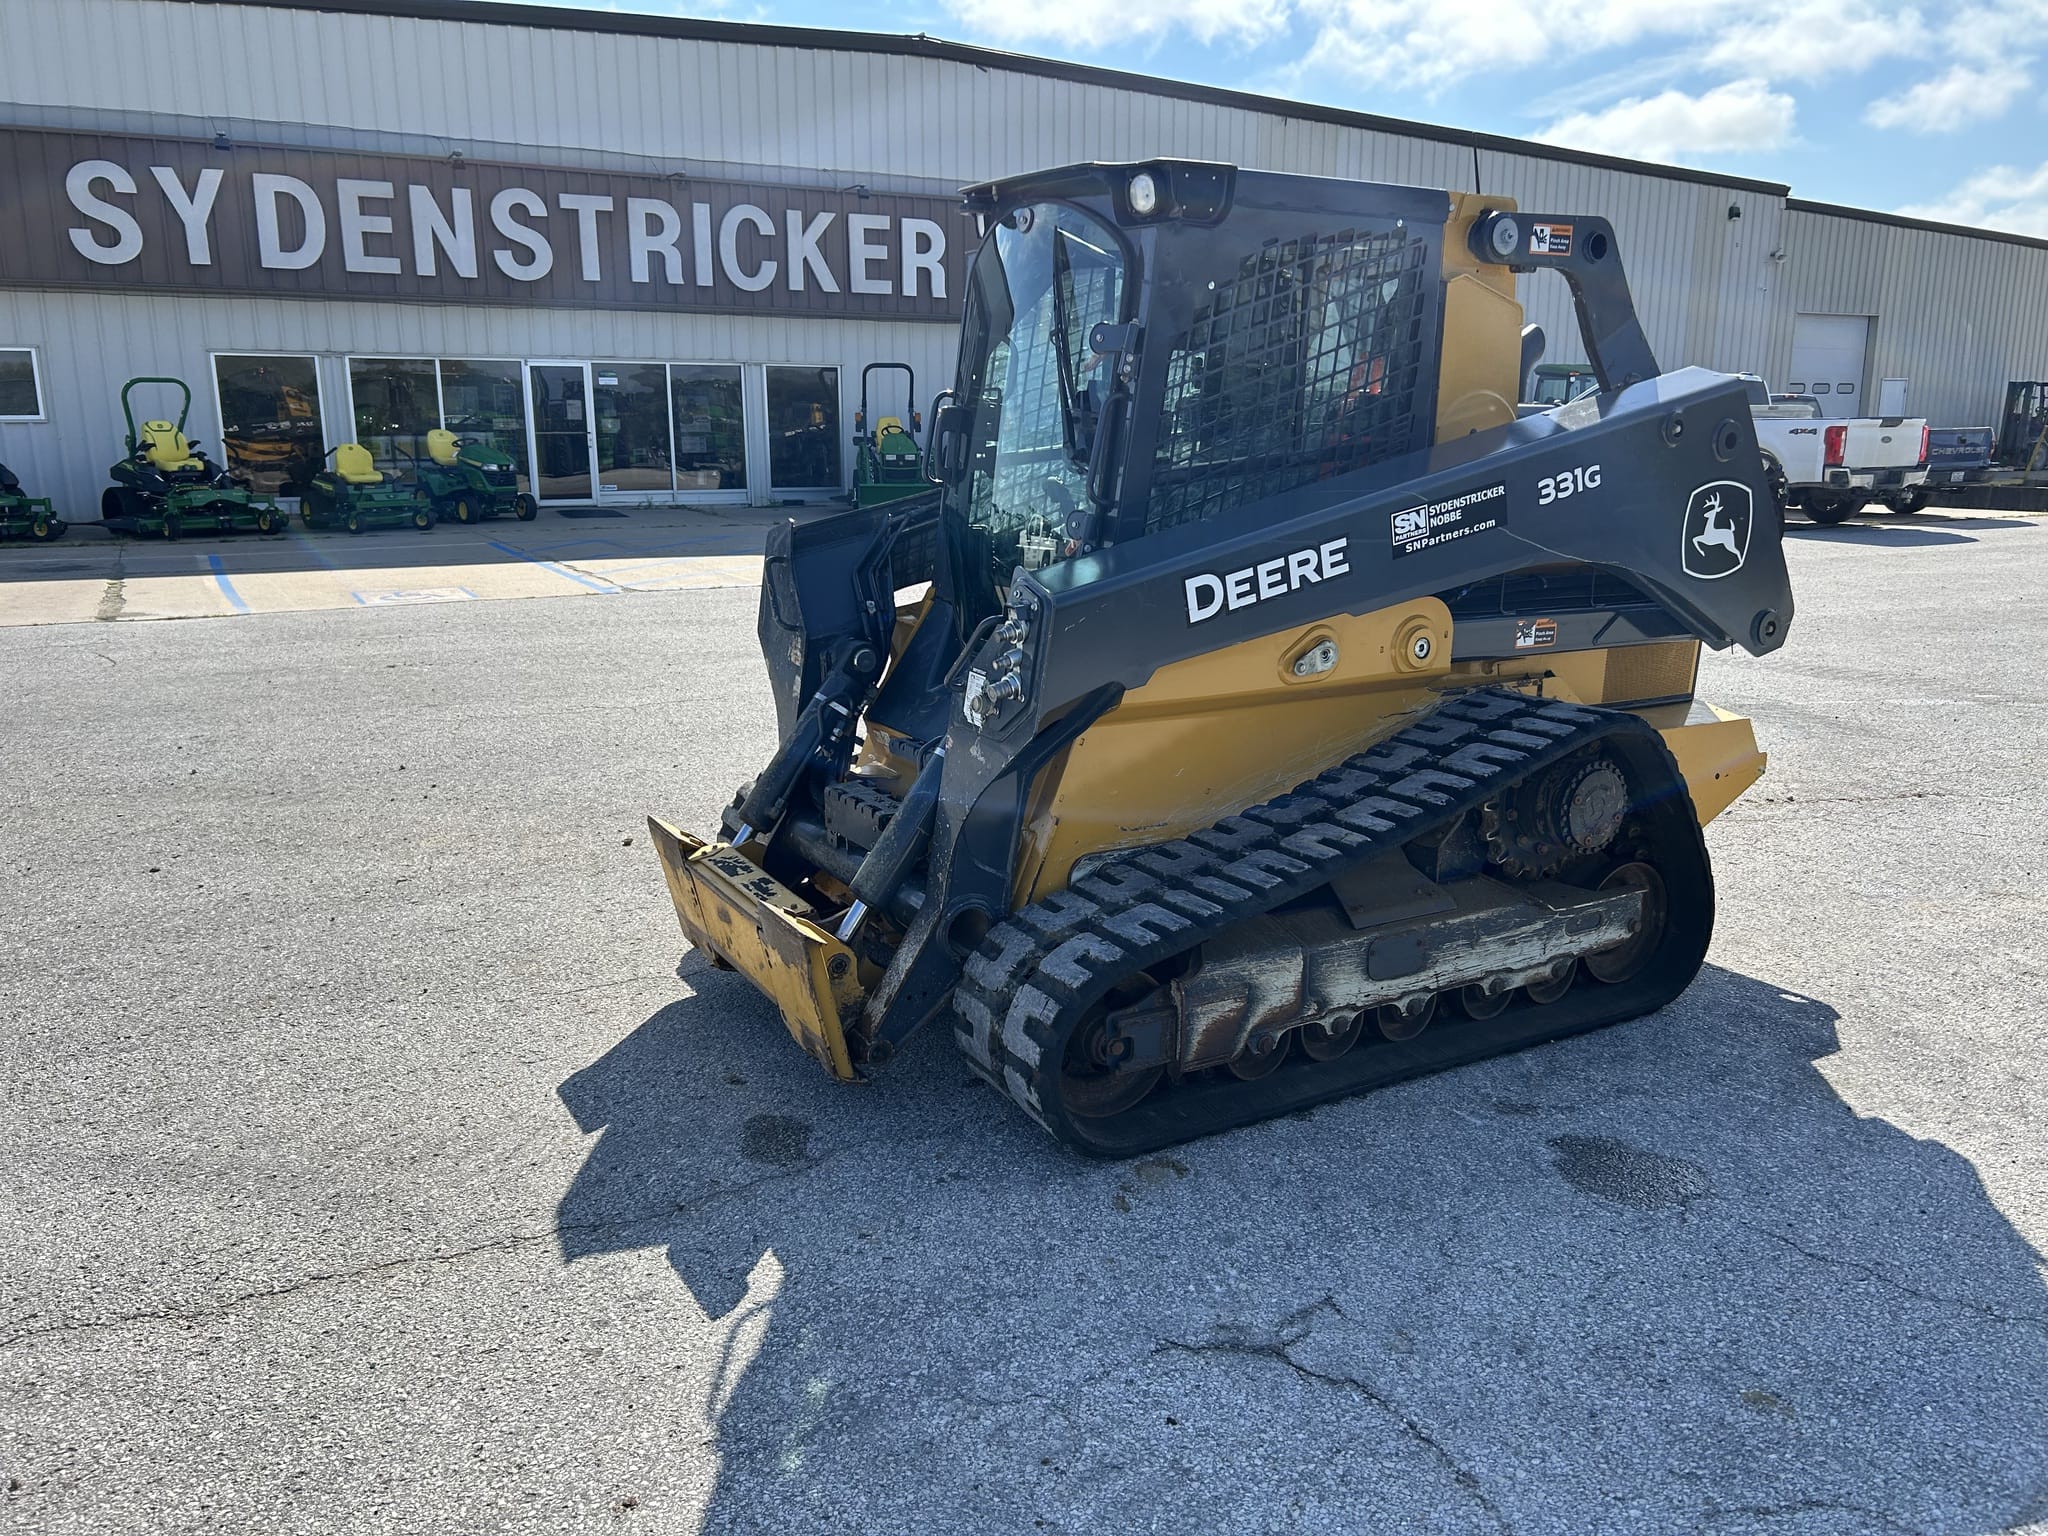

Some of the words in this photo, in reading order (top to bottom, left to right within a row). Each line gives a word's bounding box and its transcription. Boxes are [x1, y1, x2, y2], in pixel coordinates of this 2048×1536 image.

[65, 159, 947, 299] SYDENSTRICKER
[1932, 446, 1987, 456] CHEVROLET
[1429, 485, 1505, 516] SYDENSTRICKER
[1538, 465, 1601, 505] 331G
[1394, 509, 1426, 534] SN
[1430, 509, 1462, 528] NOBBE
[1395, 528, 1427, 542] PARTNERS
[1405, 519, 1496, 553] SNPartners.com
[1185, 537, 1350, 623] DEERE
